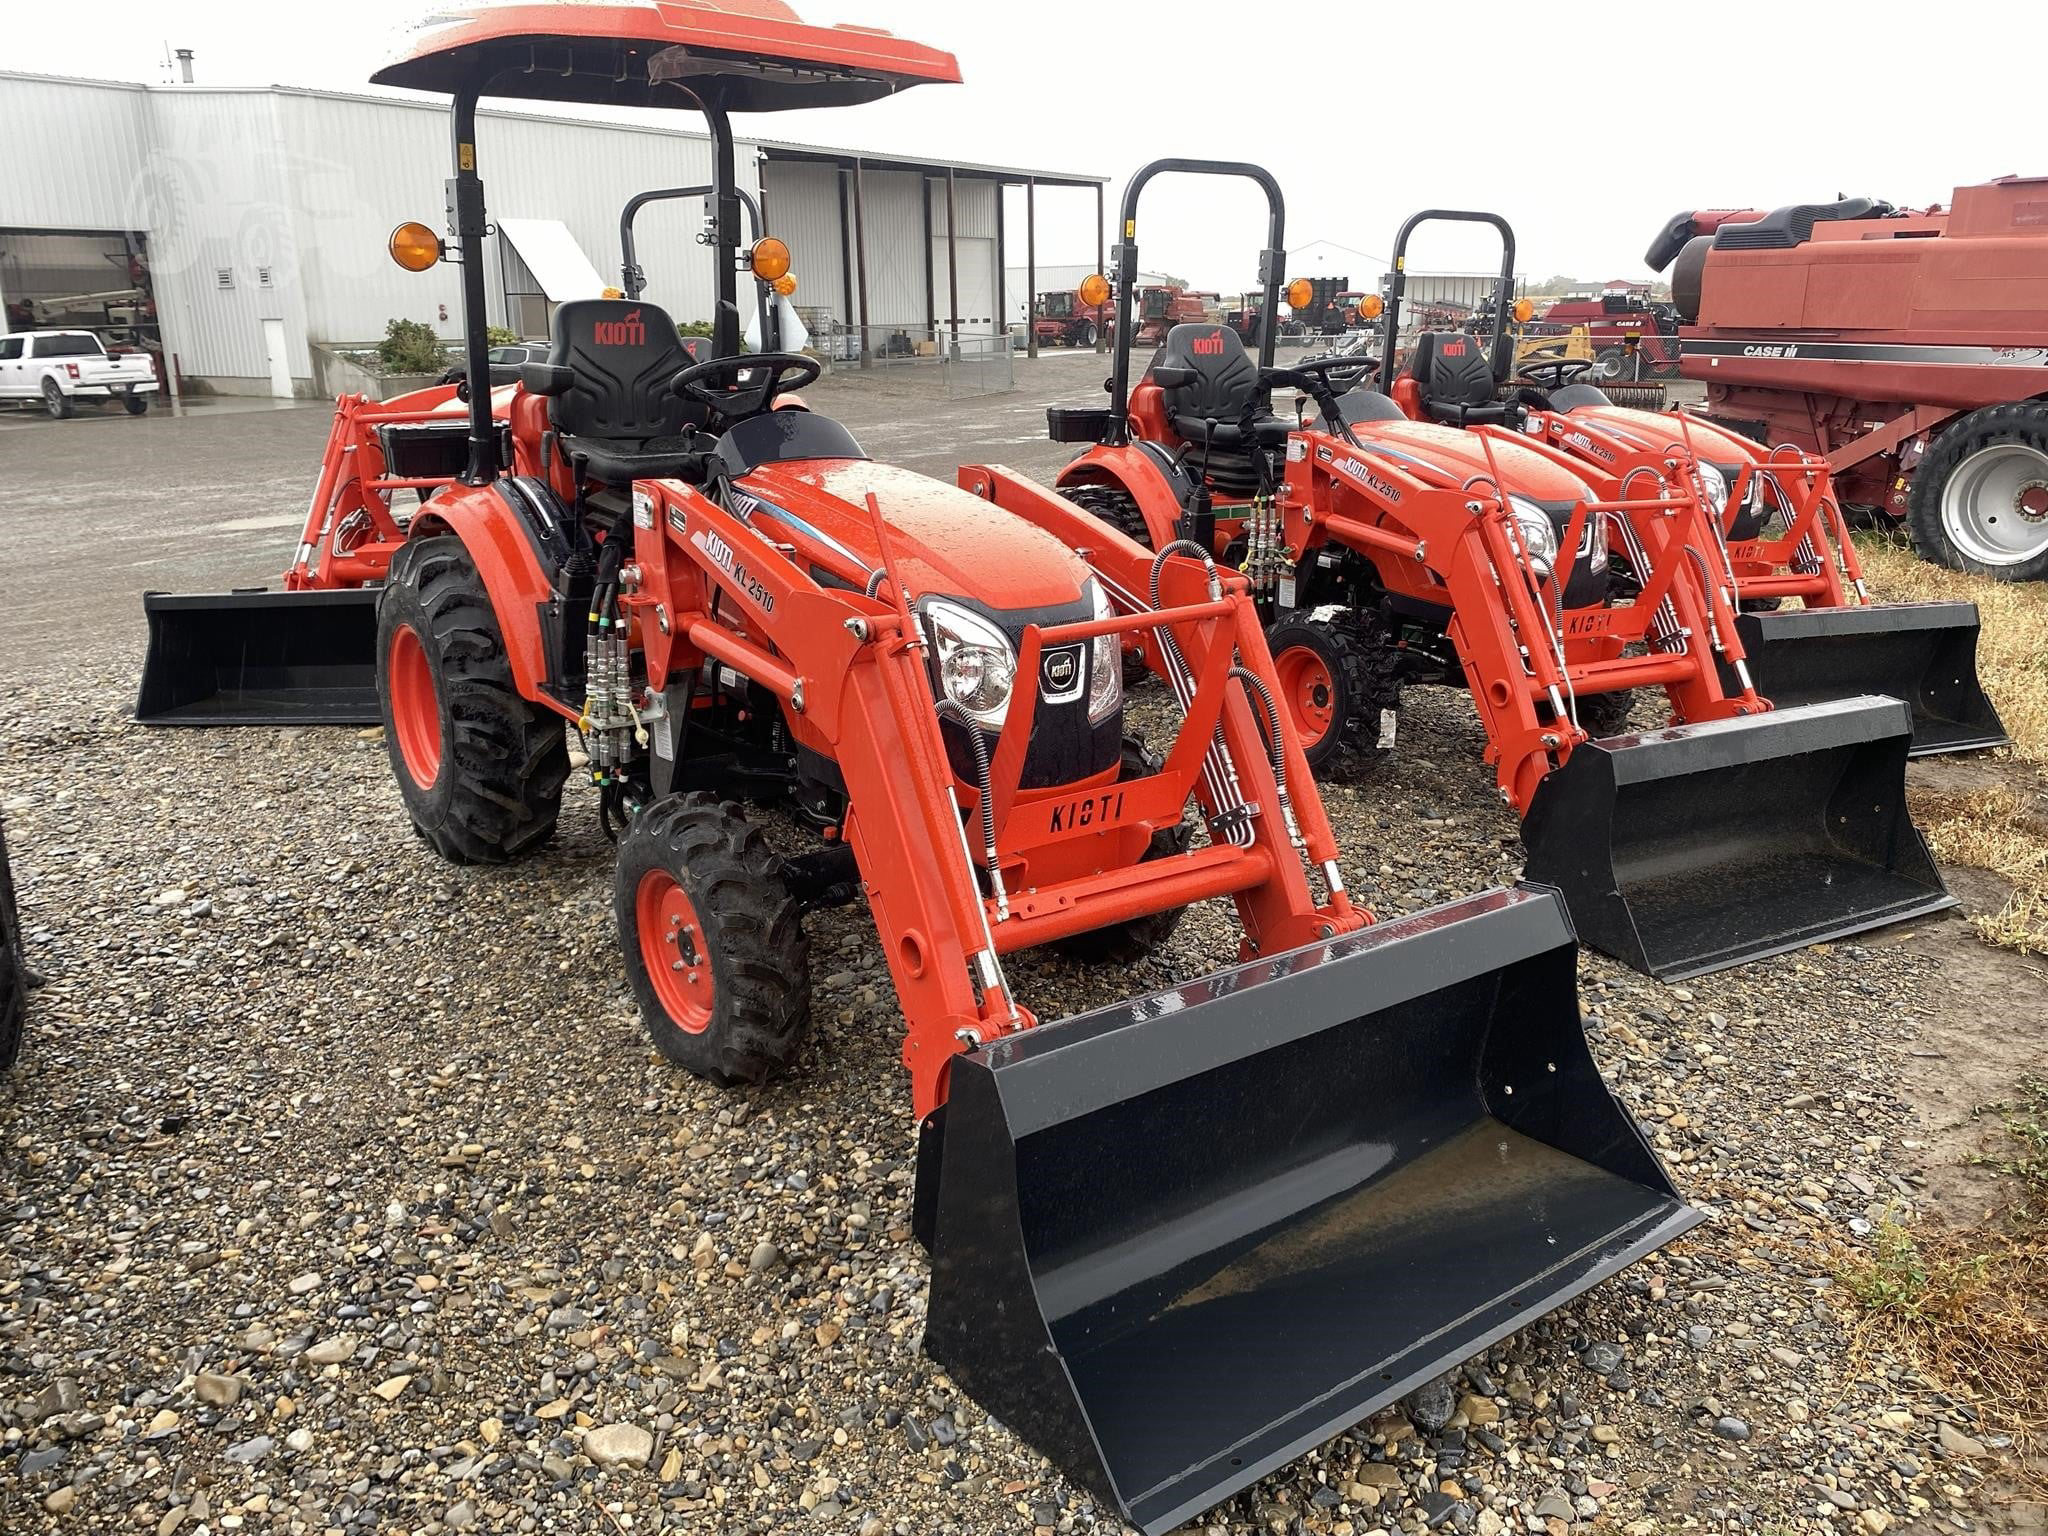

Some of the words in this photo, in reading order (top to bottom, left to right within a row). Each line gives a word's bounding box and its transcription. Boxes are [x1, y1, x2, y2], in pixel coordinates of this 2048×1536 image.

[594, 321, 646, 346] KIOTI
[1193, 338, 1224, 355] KIOTI
[1743, 345, 1784, 358] CASE
[2001, 351, 2017, 359] AFS
[1598, 447, 1616, 462] 2510
[1343, 456, 1369, 480] KIOTI
[1367, 474, 1378, 490] KL
[1379, 481, 1401, 502] 2510
[704, 529, 734, 573] KIOTI
[733, 561, 747, 589] KL
[749, 576, 775, 613] 2510
[1569, 614, 1612, 634] KIOTI
[1051, 663, 1072, 678] KIOTI
[1049, 791, 1125, 834] KIOTI
